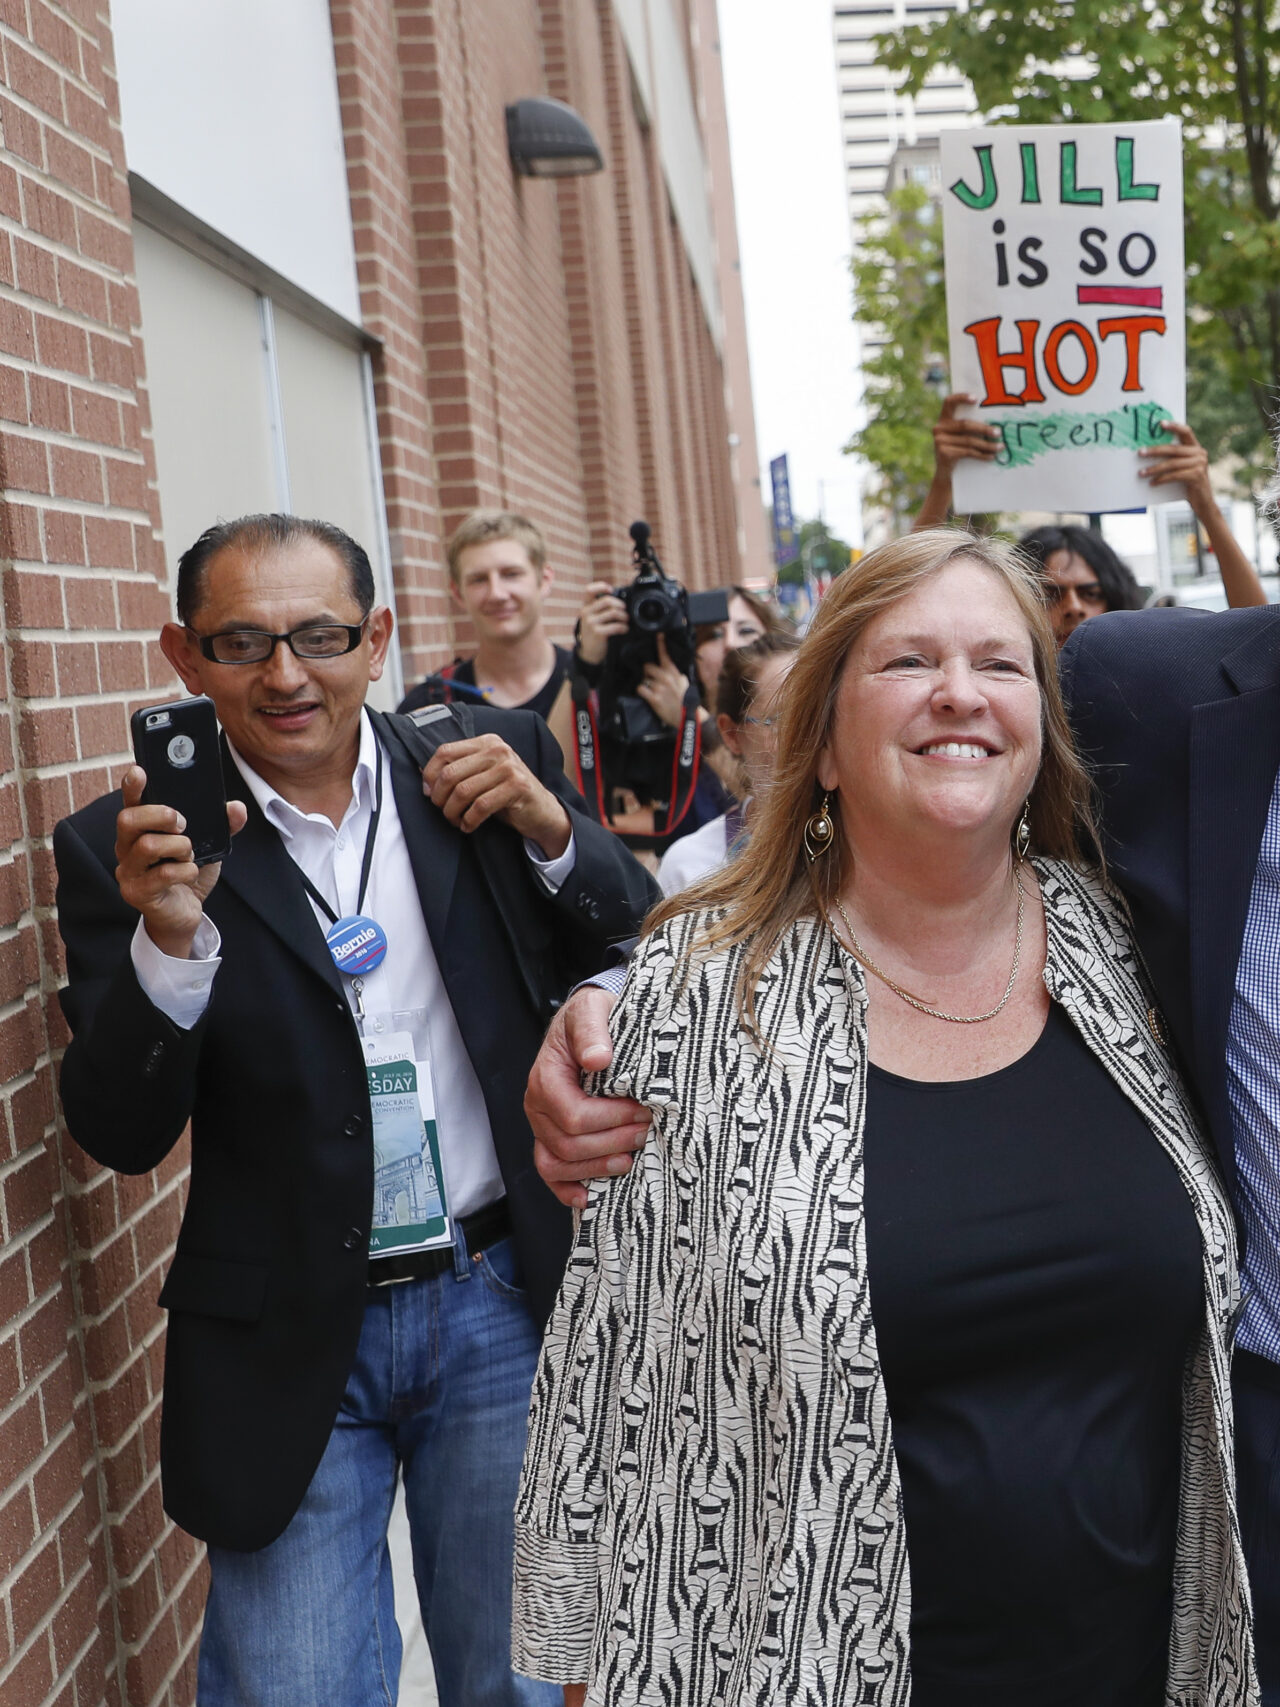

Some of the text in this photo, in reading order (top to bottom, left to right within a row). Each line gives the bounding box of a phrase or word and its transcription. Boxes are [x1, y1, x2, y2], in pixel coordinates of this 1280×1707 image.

[950, 136, 1160, 210] JILL
[993, 218, 1048, 288] is
[963, 315, 1167, 407] HOT
[990, 419, 1114, 466] green
[680, 720, 696, 767] Canon
[330, 928, 376, 961] Bernie
[366, 1053, 409, 1065] EMOCRATIC
[372, 1098, 414, 1108] EMOCRATIC
